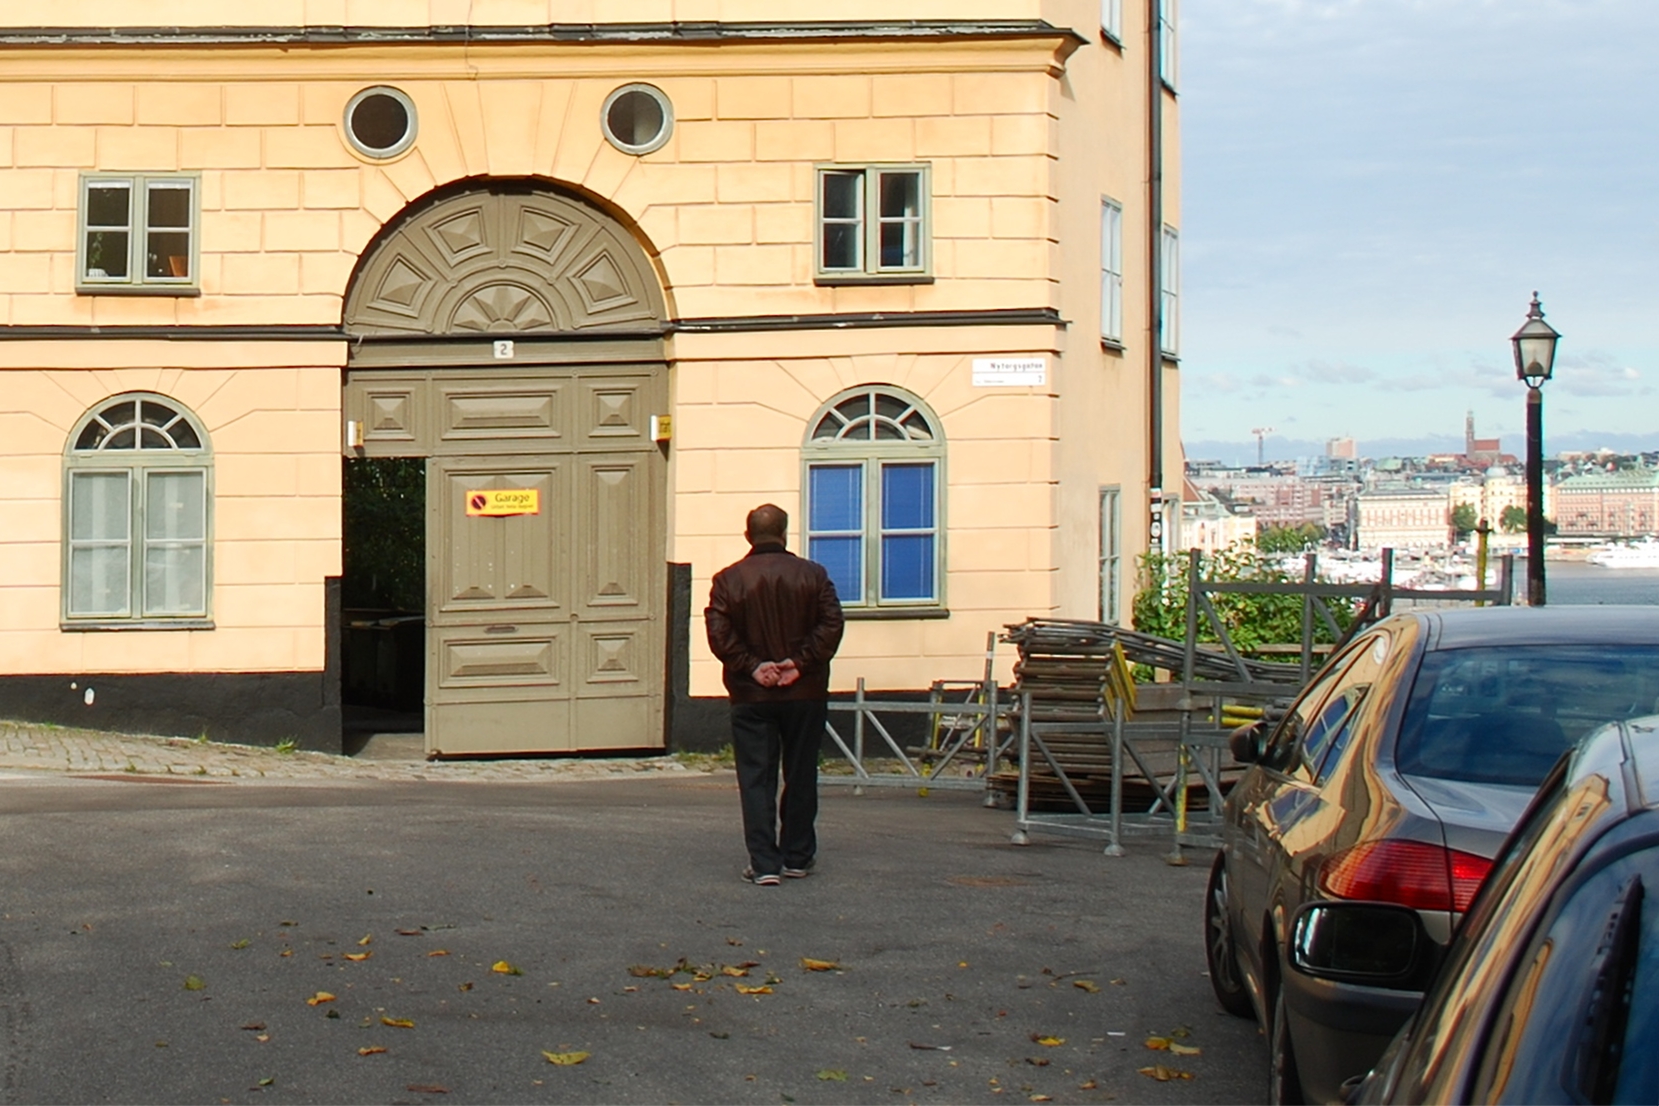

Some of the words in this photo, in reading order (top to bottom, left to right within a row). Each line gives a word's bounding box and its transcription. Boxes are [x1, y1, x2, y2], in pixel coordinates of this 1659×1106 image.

[500, 343, 508, 355] 2
[990, 363, 1043, 372] Nytorgsgatan
[495, 493, 530, 504] Garage
